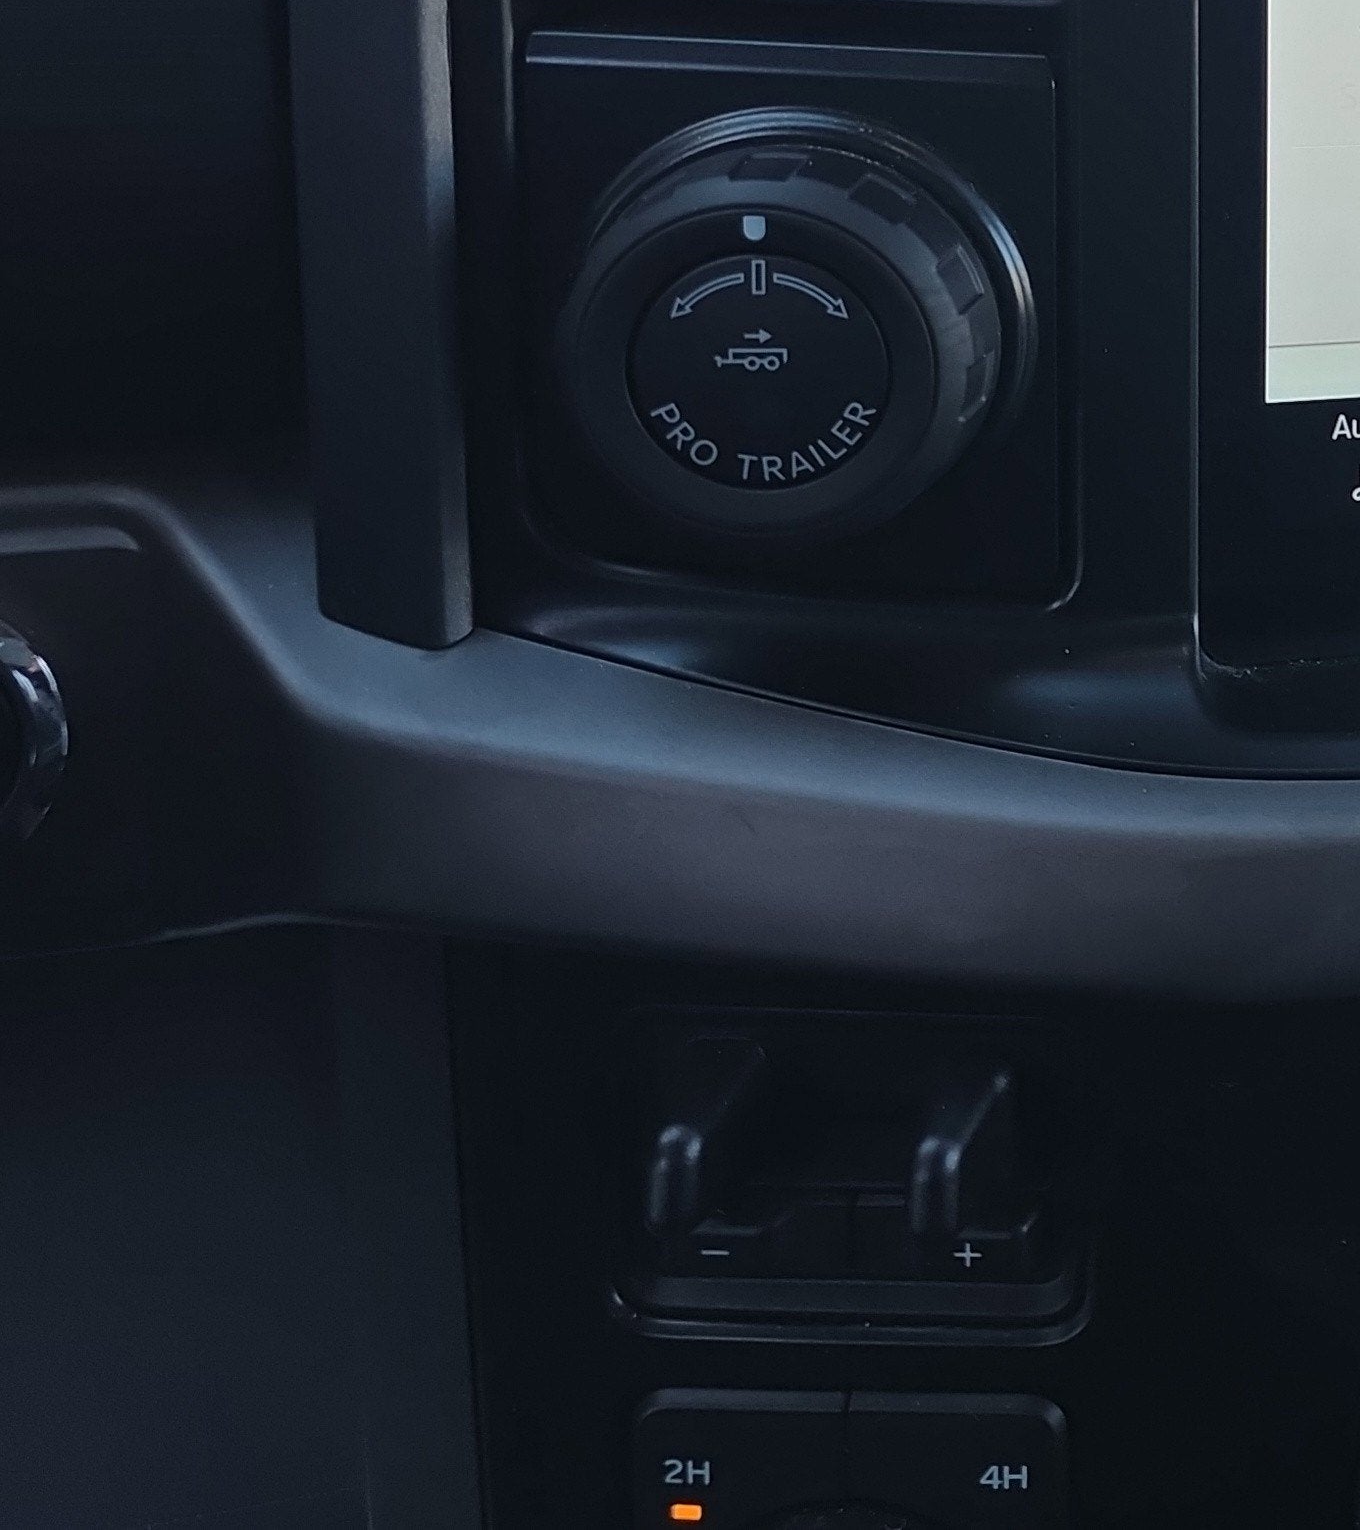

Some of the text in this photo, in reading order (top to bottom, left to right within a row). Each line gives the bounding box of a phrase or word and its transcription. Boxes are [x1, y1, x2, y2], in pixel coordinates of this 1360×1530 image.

[650, 402, 877, 482] PRO TRAILER
[664, 1459, 710, 1486] 2H
[979, 1465, 1028, 1490] 4H
